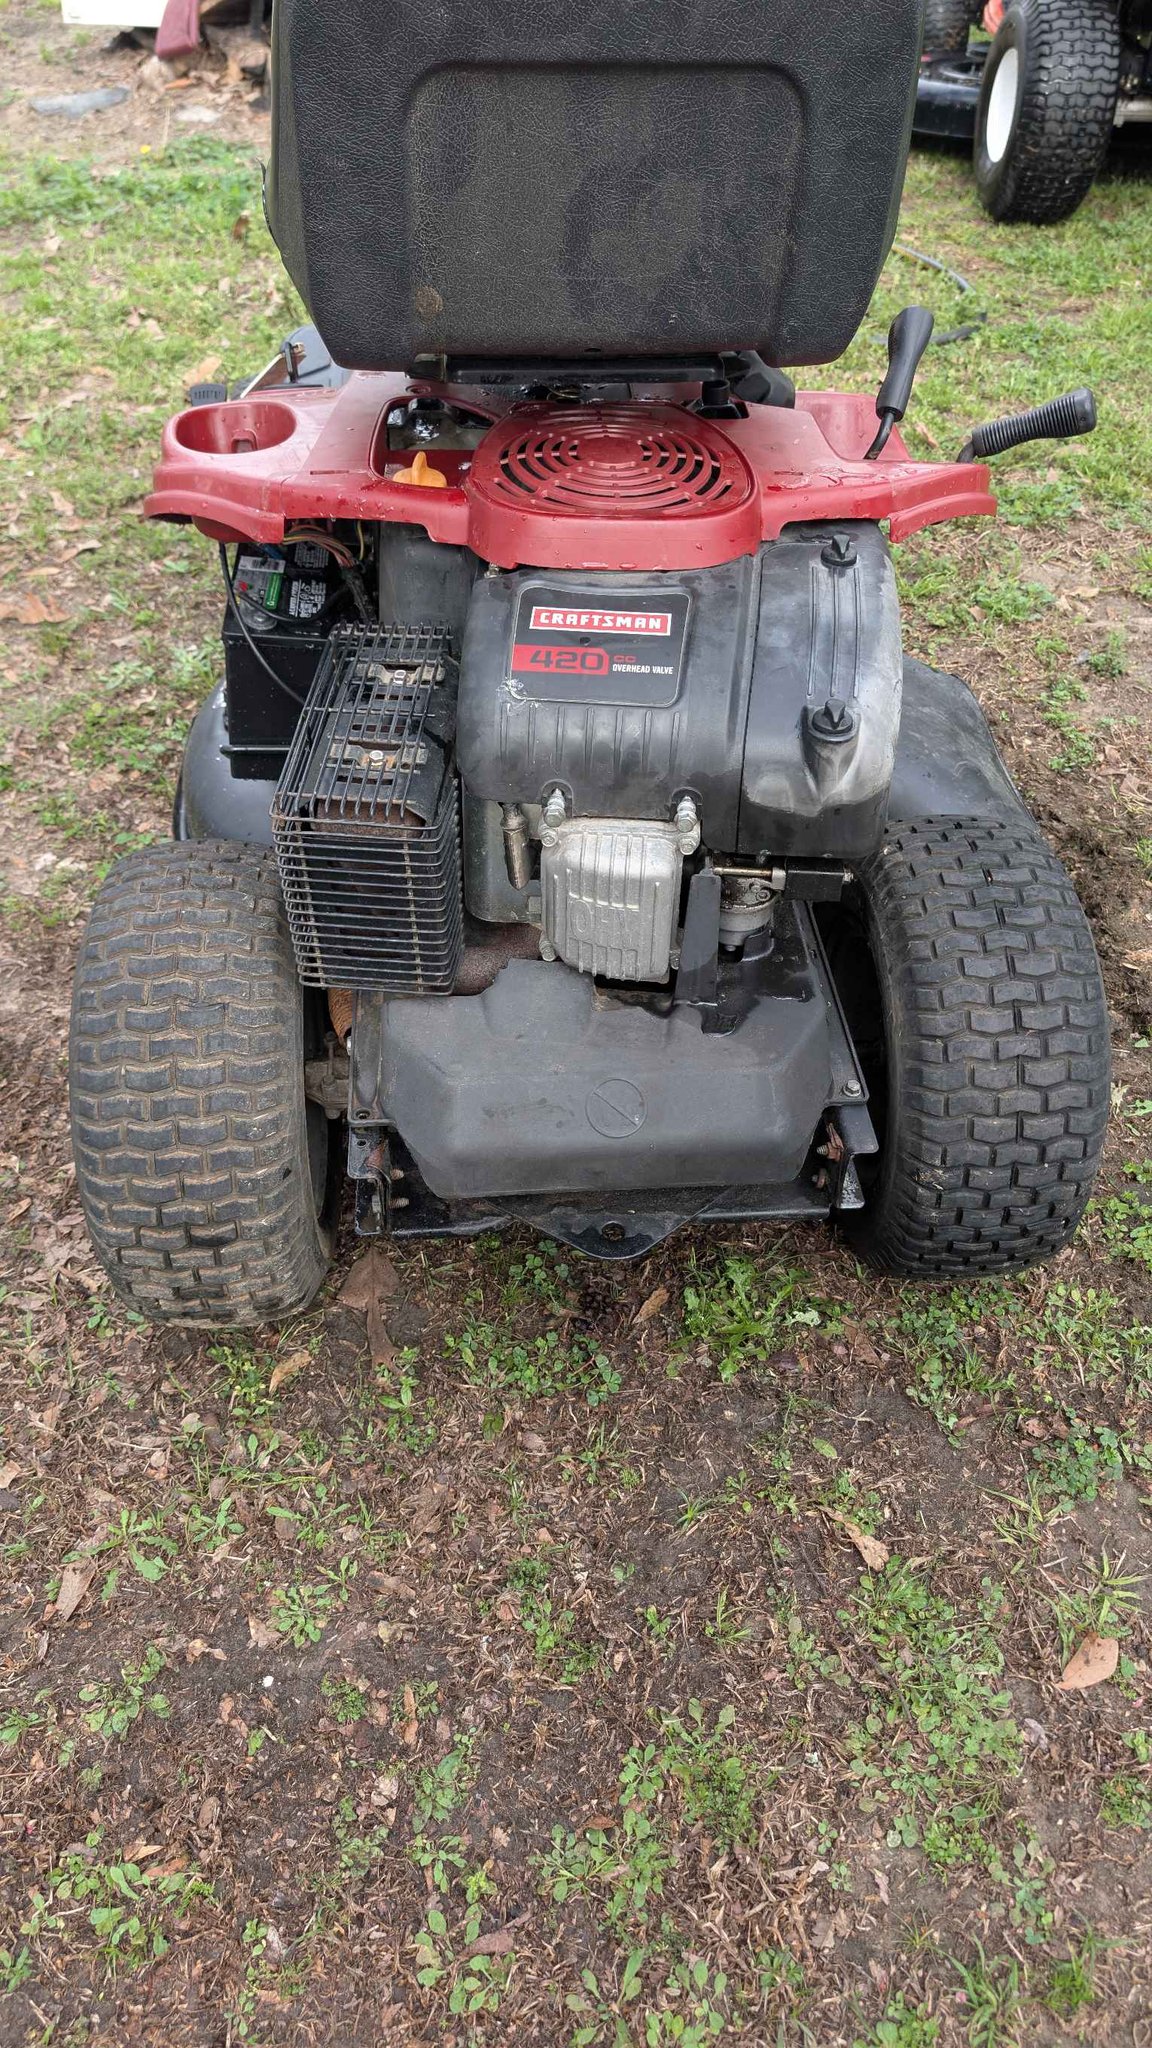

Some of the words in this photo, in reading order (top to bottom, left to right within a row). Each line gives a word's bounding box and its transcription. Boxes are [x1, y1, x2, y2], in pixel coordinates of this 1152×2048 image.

[539, 612, 661, 630] CRAFTSMAN
[530, 650, 604, 671] 420
[612, 663, 651, 674] OVERHEAD
[652, 665, 674, 675] VALVE
